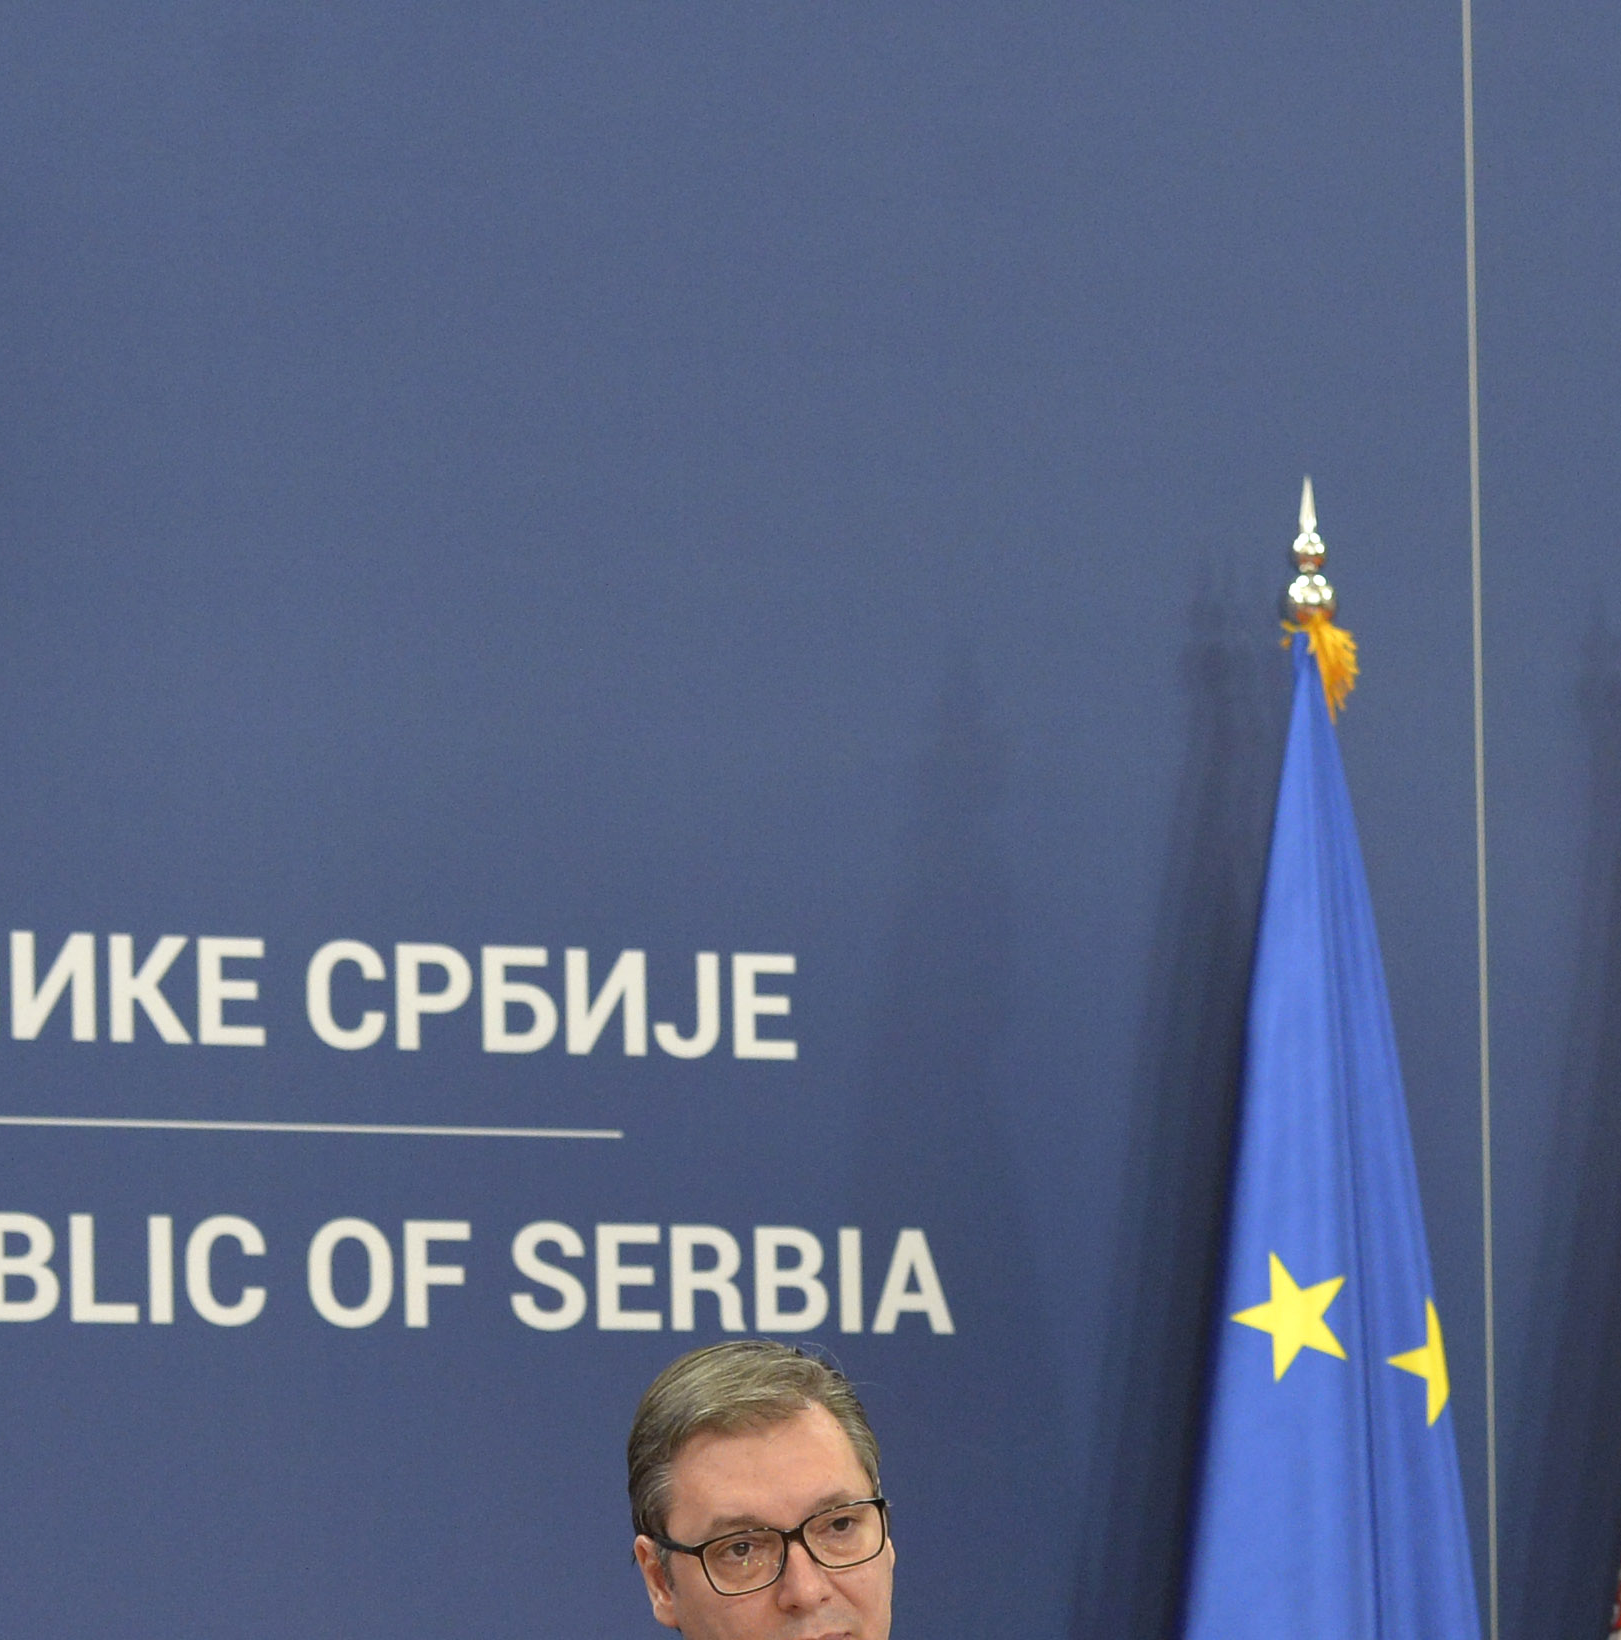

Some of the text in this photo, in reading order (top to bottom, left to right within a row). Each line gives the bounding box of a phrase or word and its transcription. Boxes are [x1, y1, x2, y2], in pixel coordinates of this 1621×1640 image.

[306, 939, 797, 1060] СРБИЈЕ
[308, 1217, 471, 1328] OF
[511, 1221, 954, 1334] SERBIA
